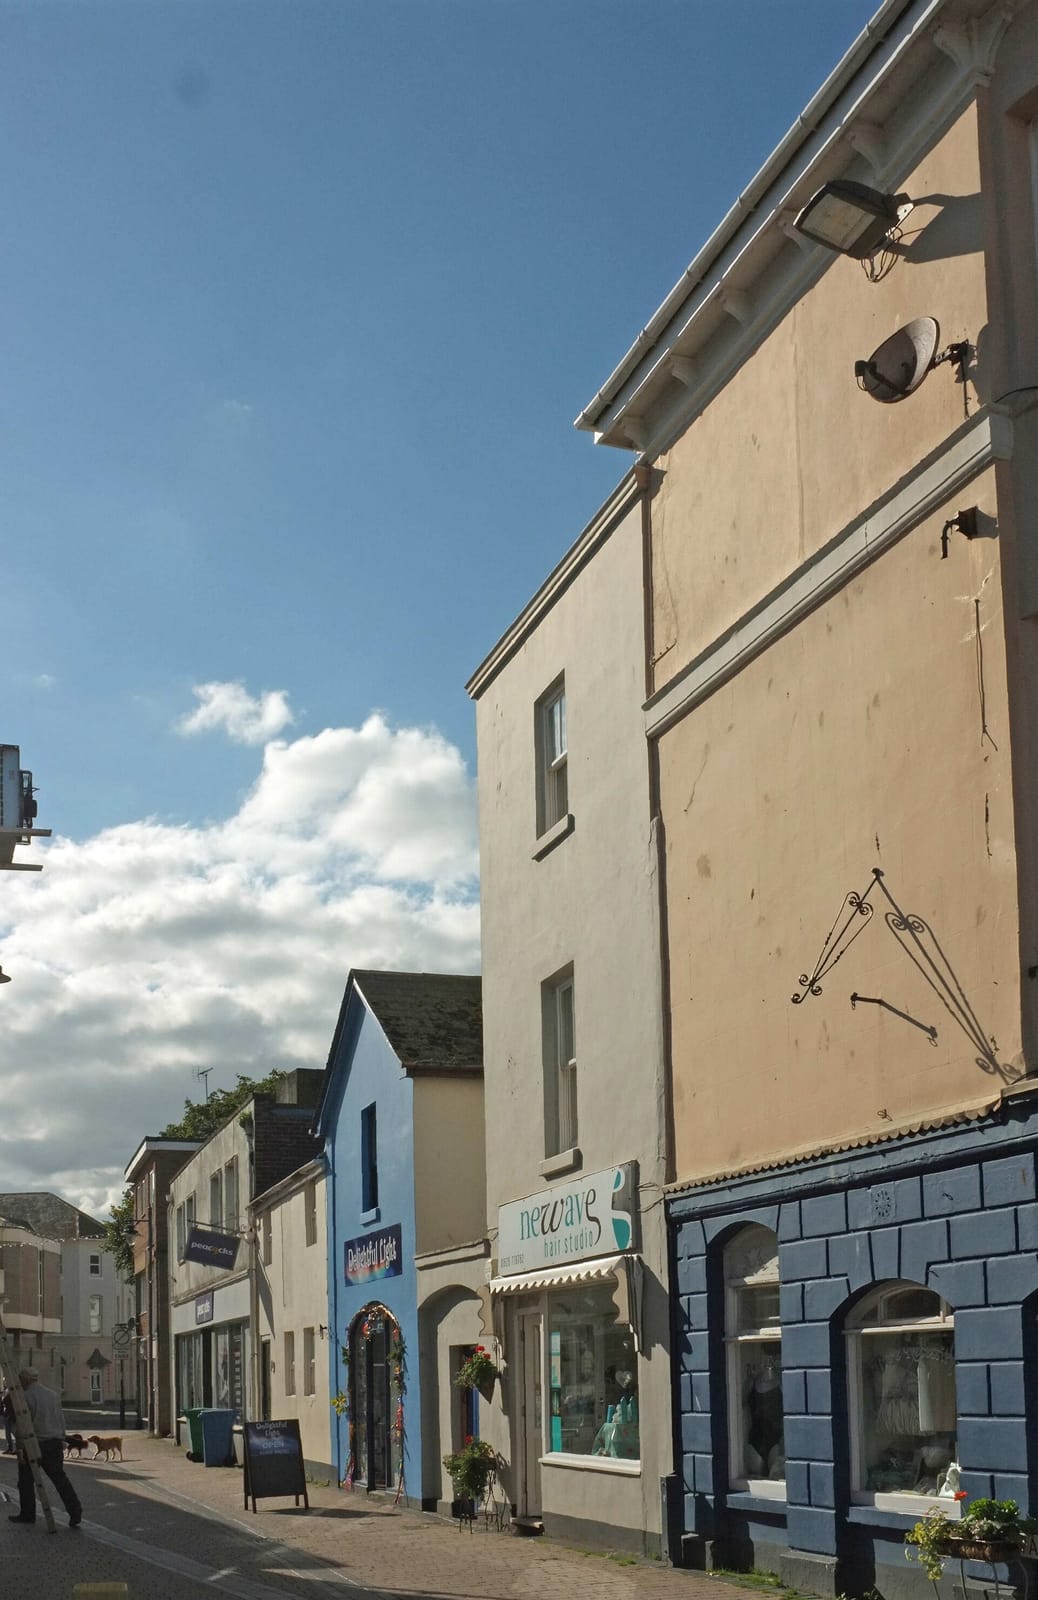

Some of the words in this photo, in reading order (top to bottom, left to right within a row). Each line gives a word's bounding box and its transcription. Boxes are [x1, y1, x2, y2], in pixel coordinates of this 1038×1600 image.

[520, 1188, 601, 1246] newave
[191, 1241, 233, 1256] peacocks
[348, 1240, 378, 1272] Delightful
[379, 1236, 397, 1269] Light
[544, 1236, 561, 1258] hair
[564, 1227, 593, 1254] studio
